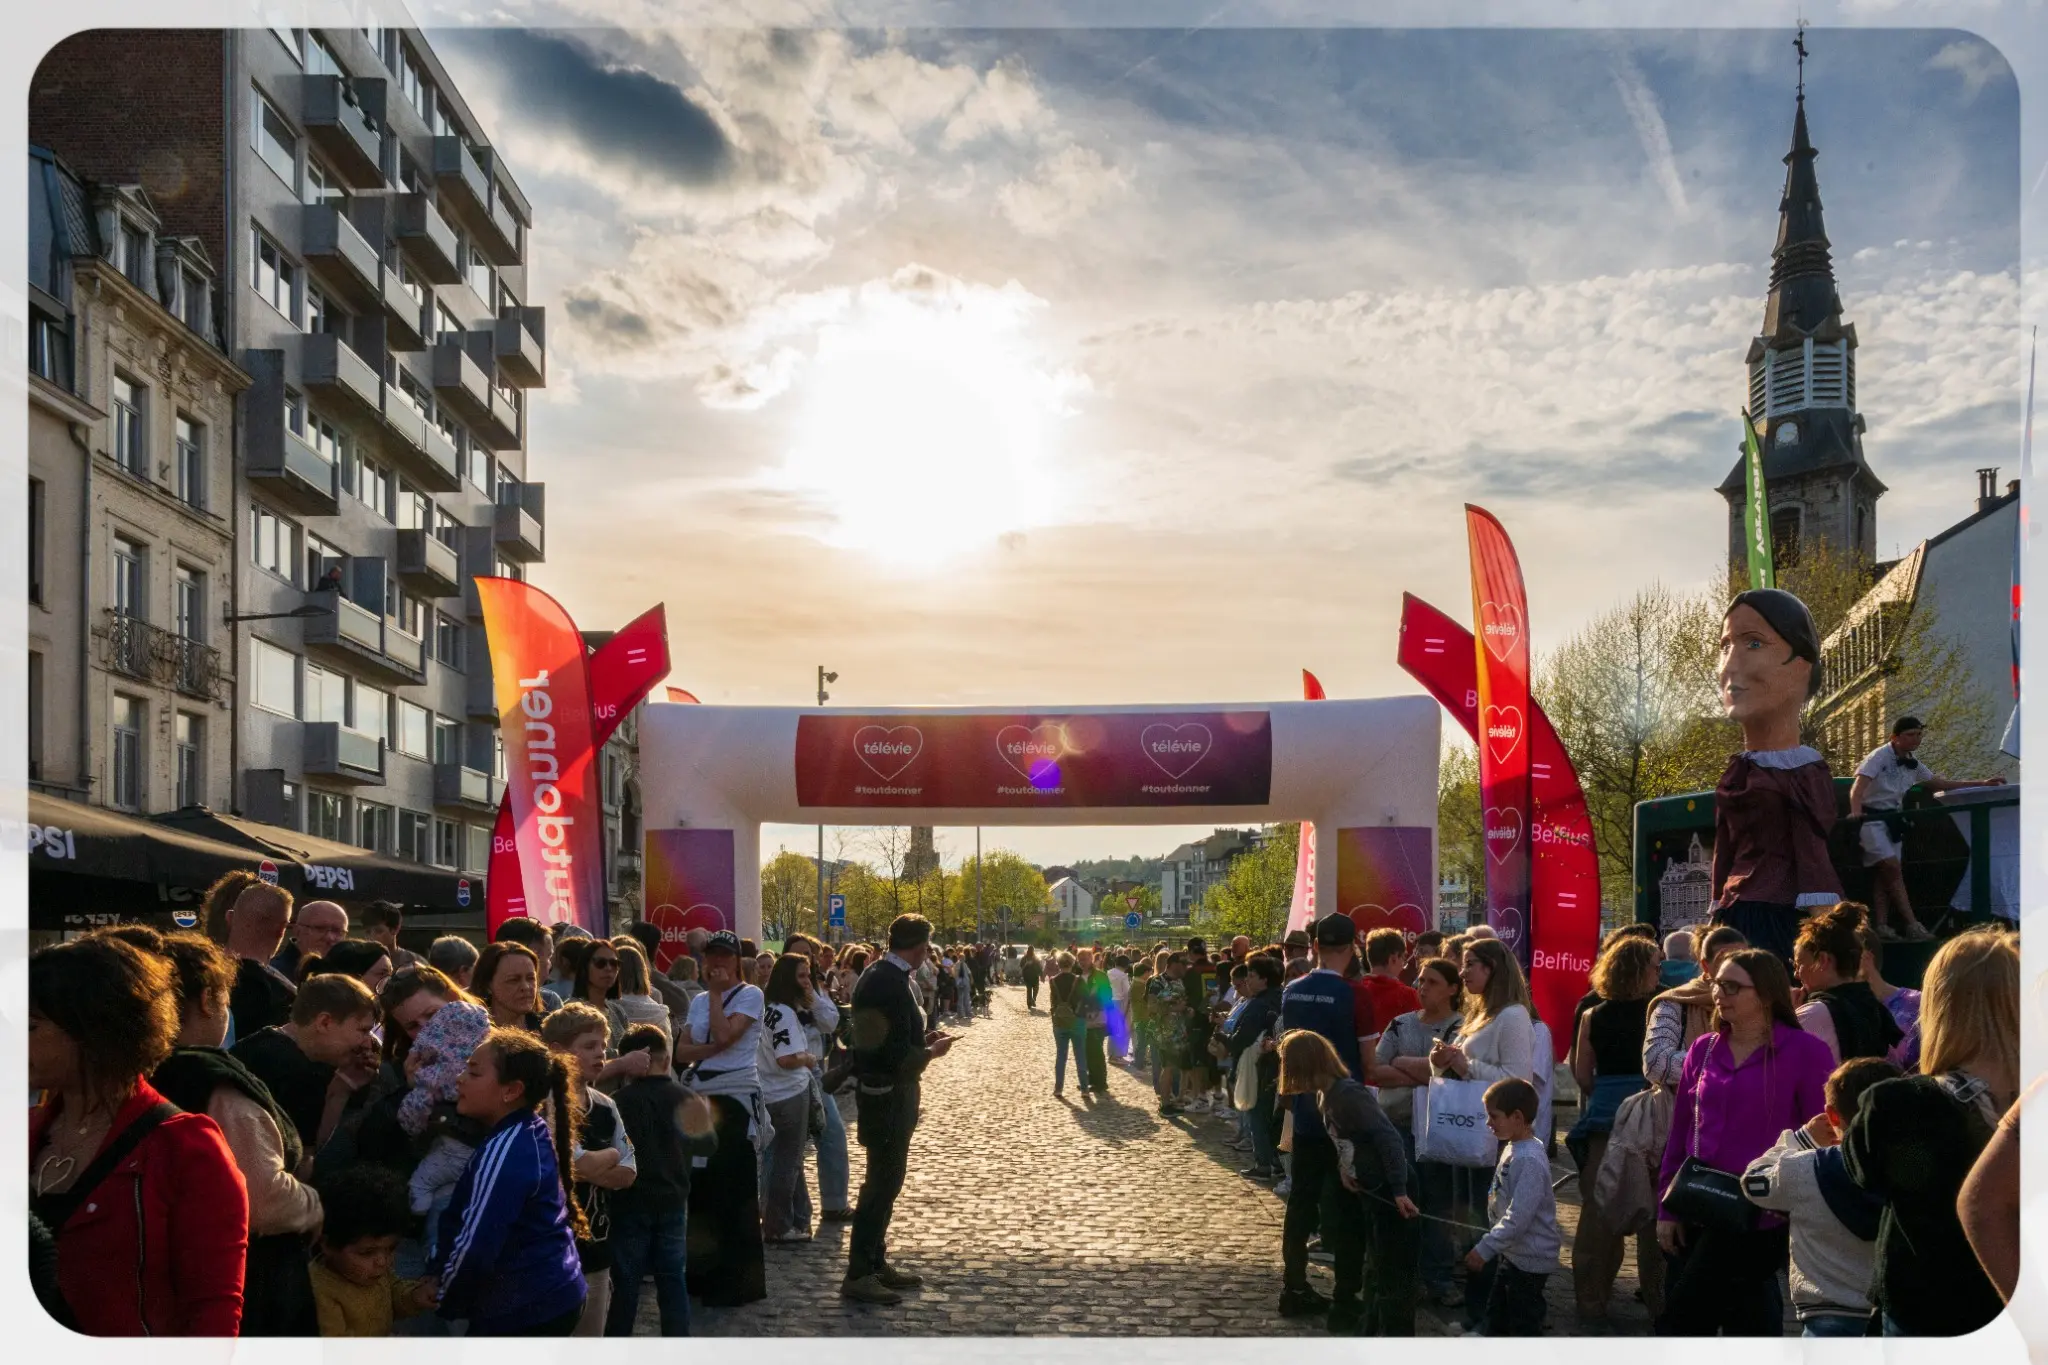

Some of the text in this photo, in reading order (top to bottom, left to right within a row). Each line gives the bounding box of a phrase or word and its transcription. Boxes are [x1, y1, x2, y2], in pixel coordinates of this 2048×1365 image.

[864, 741, 912, 755] télévie
[1006, 741, 1056, 755] télévie
[1151, 740, 1202, 753] télévie
[854, 785, 923, 795] #toutdonner
[997, 785, 1066, 795] #toutdonner
[1141, 784, 1212, 794] #toutdonner
[27, 824, 76, 860] PSI
[1531, 823, 1590, 846] Belfius
[304, 864, 354, 891] PEPSI
[831, 898, 843, 915] P
[660, 926, 687, 942] télé
[1533, 950, 1590, 972] Belfius
[1437, 1112, 1475, 1127] EROS
